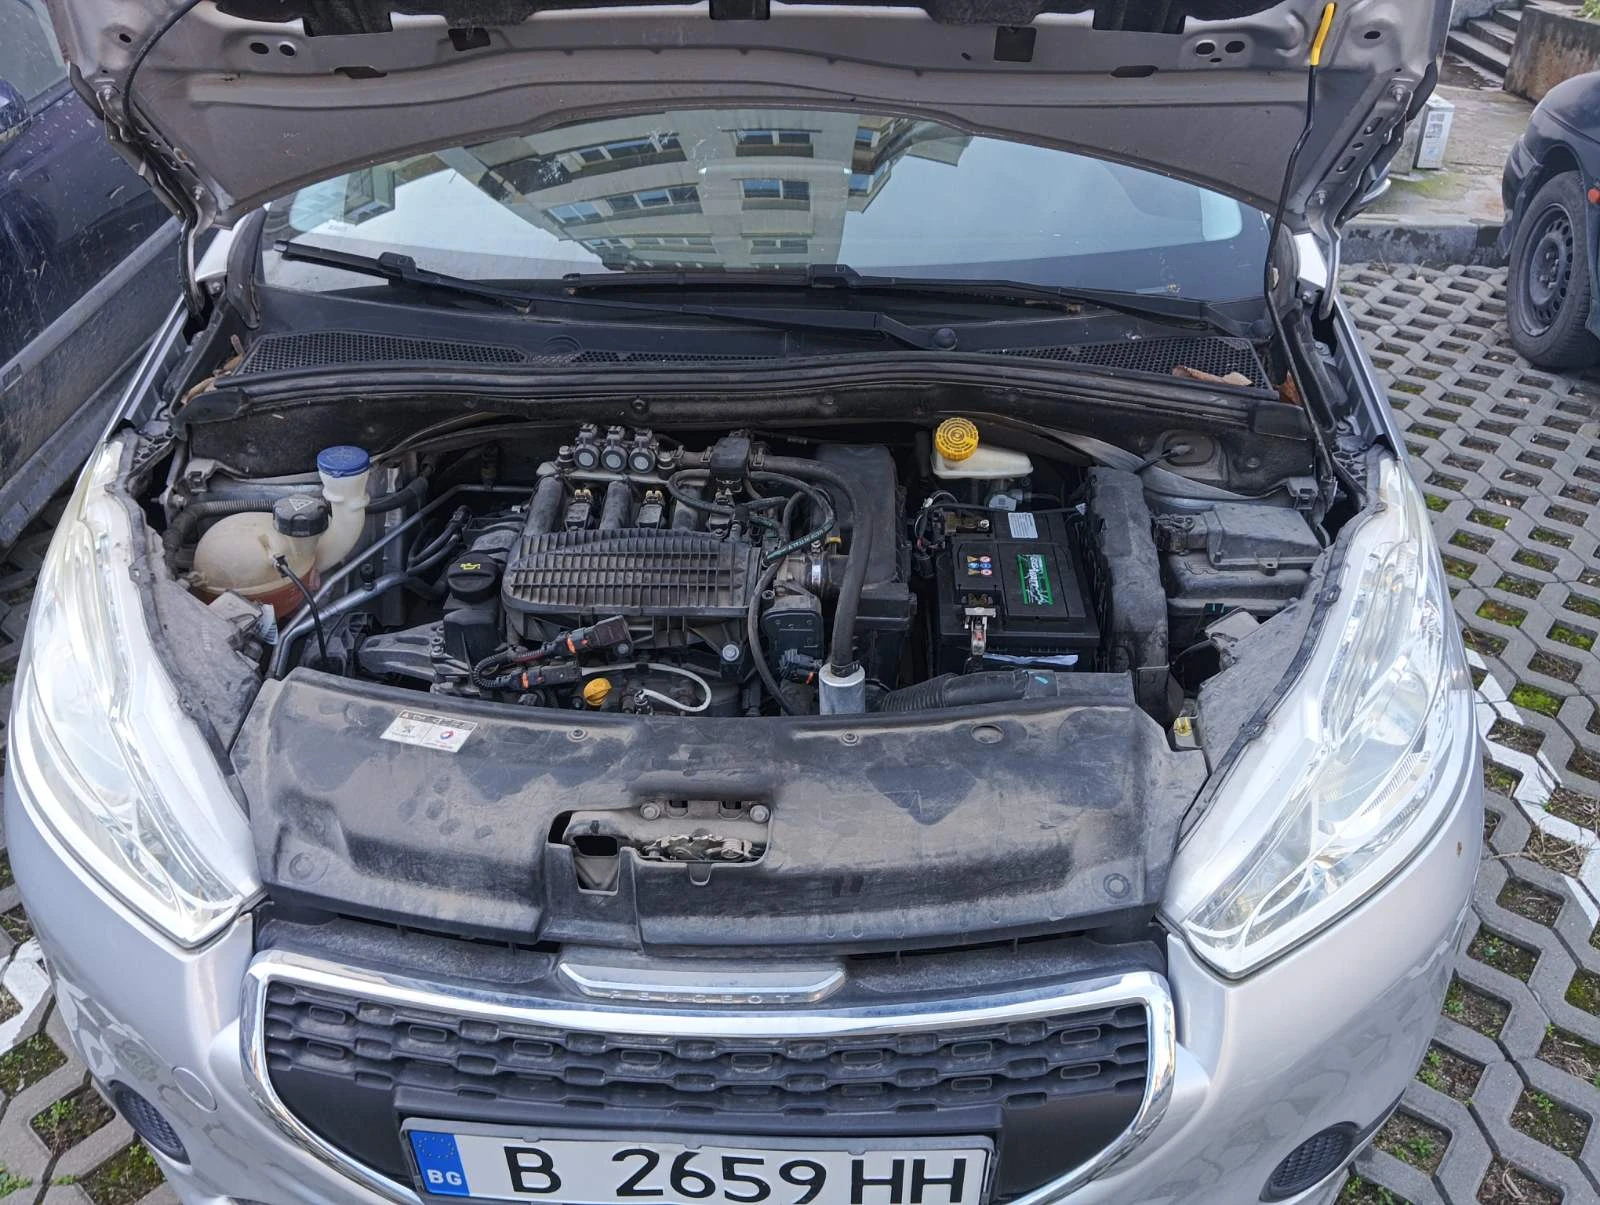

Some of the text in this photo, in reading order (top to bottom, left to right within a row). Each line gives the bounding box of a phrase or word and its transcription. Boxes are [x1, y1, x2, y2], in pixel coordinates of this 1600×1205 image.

[426, 1169, 462, 1186] BG
[503, 1146, 967, 1204] B 2659 HH
